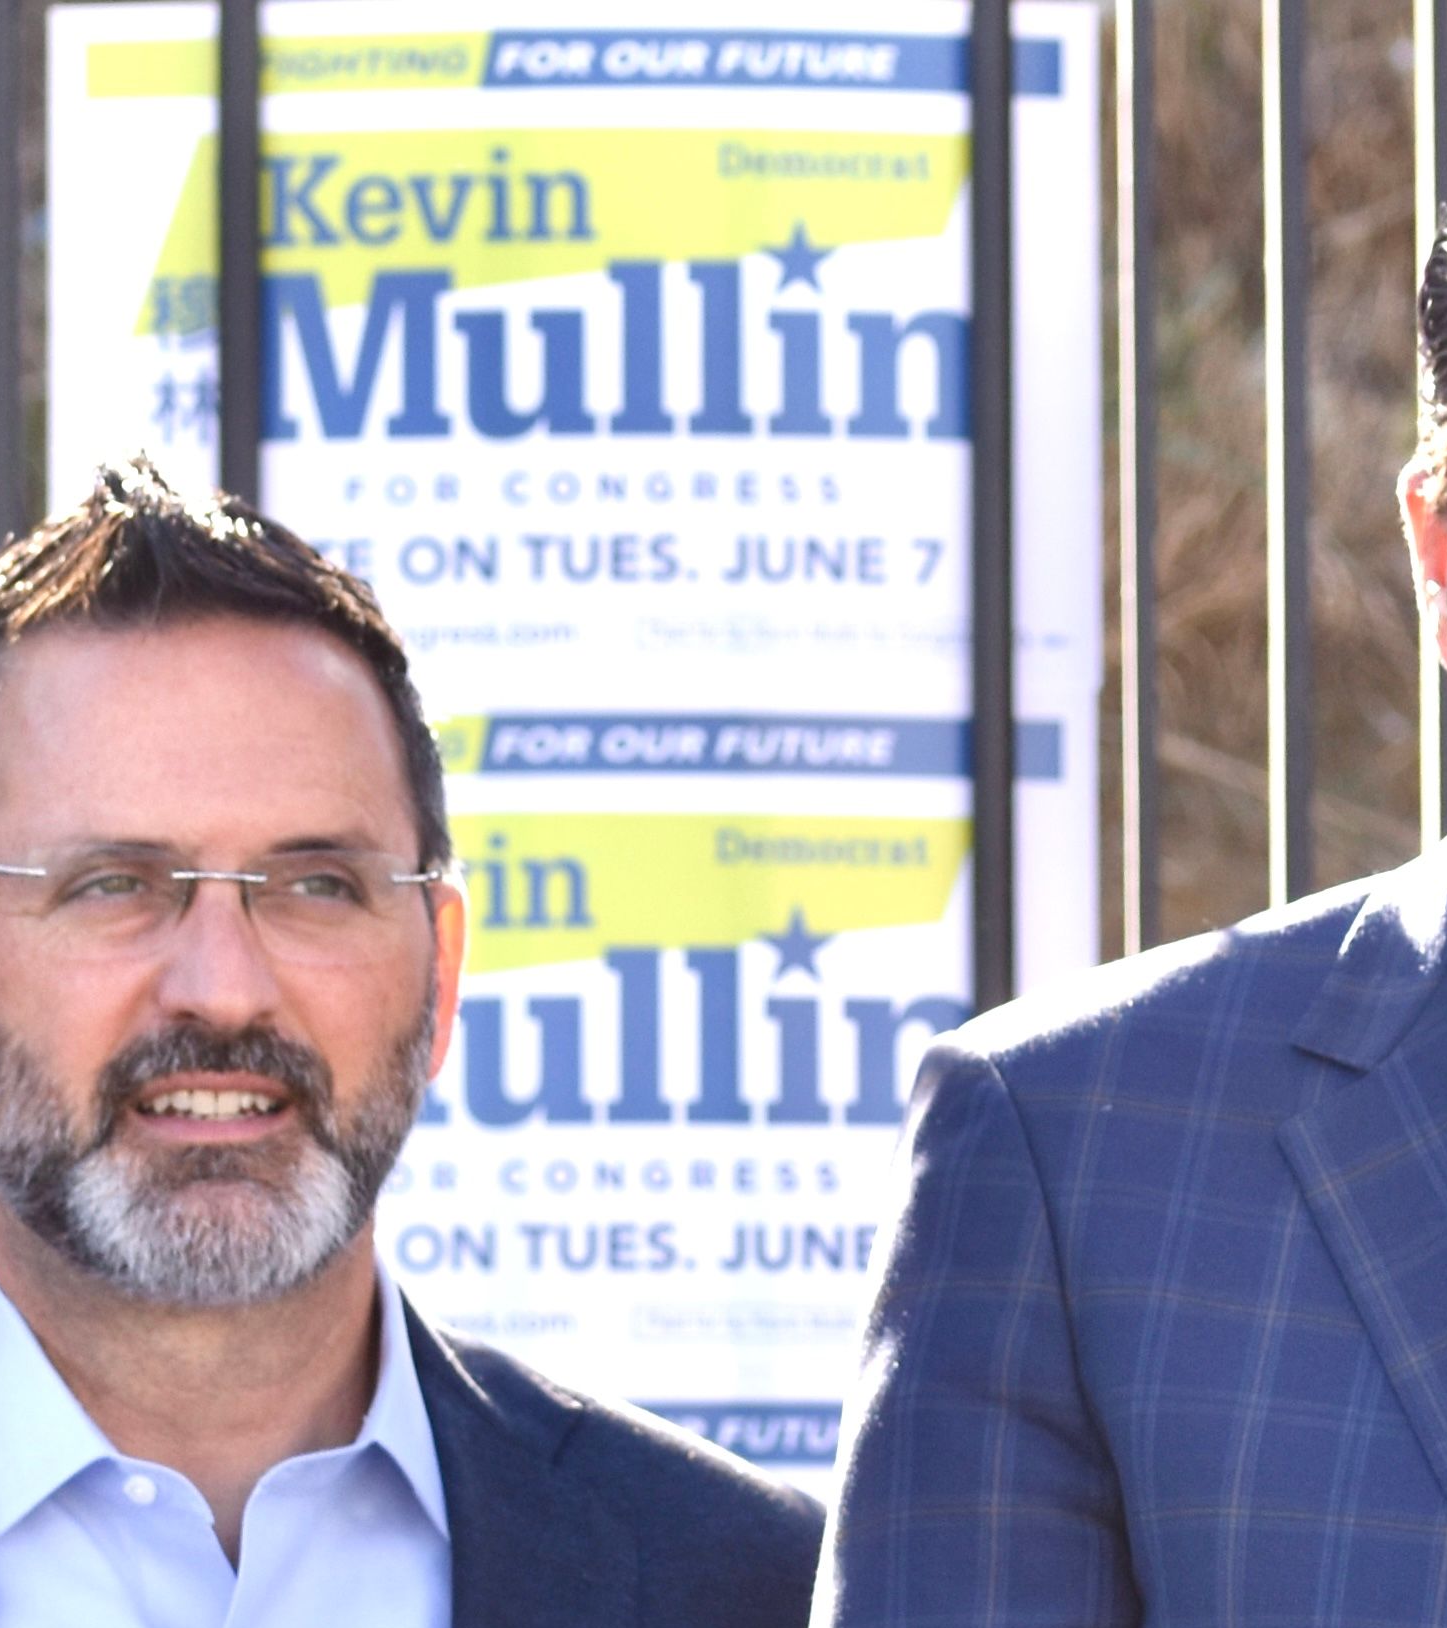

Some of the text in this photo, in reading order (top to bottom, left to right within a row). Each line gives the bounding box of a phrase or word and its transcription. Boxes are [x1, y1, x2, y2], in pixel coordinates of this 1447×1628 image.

[493, 39, 598, 80] FOR
[601, 39, 712, 81] OUR
[715, 41, 901, 83] FUTURE
[718, 141, 932, 181] Democrat
[263, 145, 597, 249] Kevin
[262, 220, 971, 441] Mullin
[344, 470, 842, 507] FOR CONGRESS
[398, 536, 500, 585] ON
[518, 536, 699, 585] TUES.
[718, 537, 888, 585] JUNE
[911, 540, 949, 585] 7
[489, 726, 595, 767] FOR
[598, 726, 708, 767] OUR
[712, 727, 898, 768] FUTURE
[714, 827, 933, 869] Democrat
[420, 901, 970, 1127] ullin
[497, 1159, 841, 1196] CONGRESS
[395, 1221, 497, 1276] ON
[517, 1221, 697, 1274] TUES.
